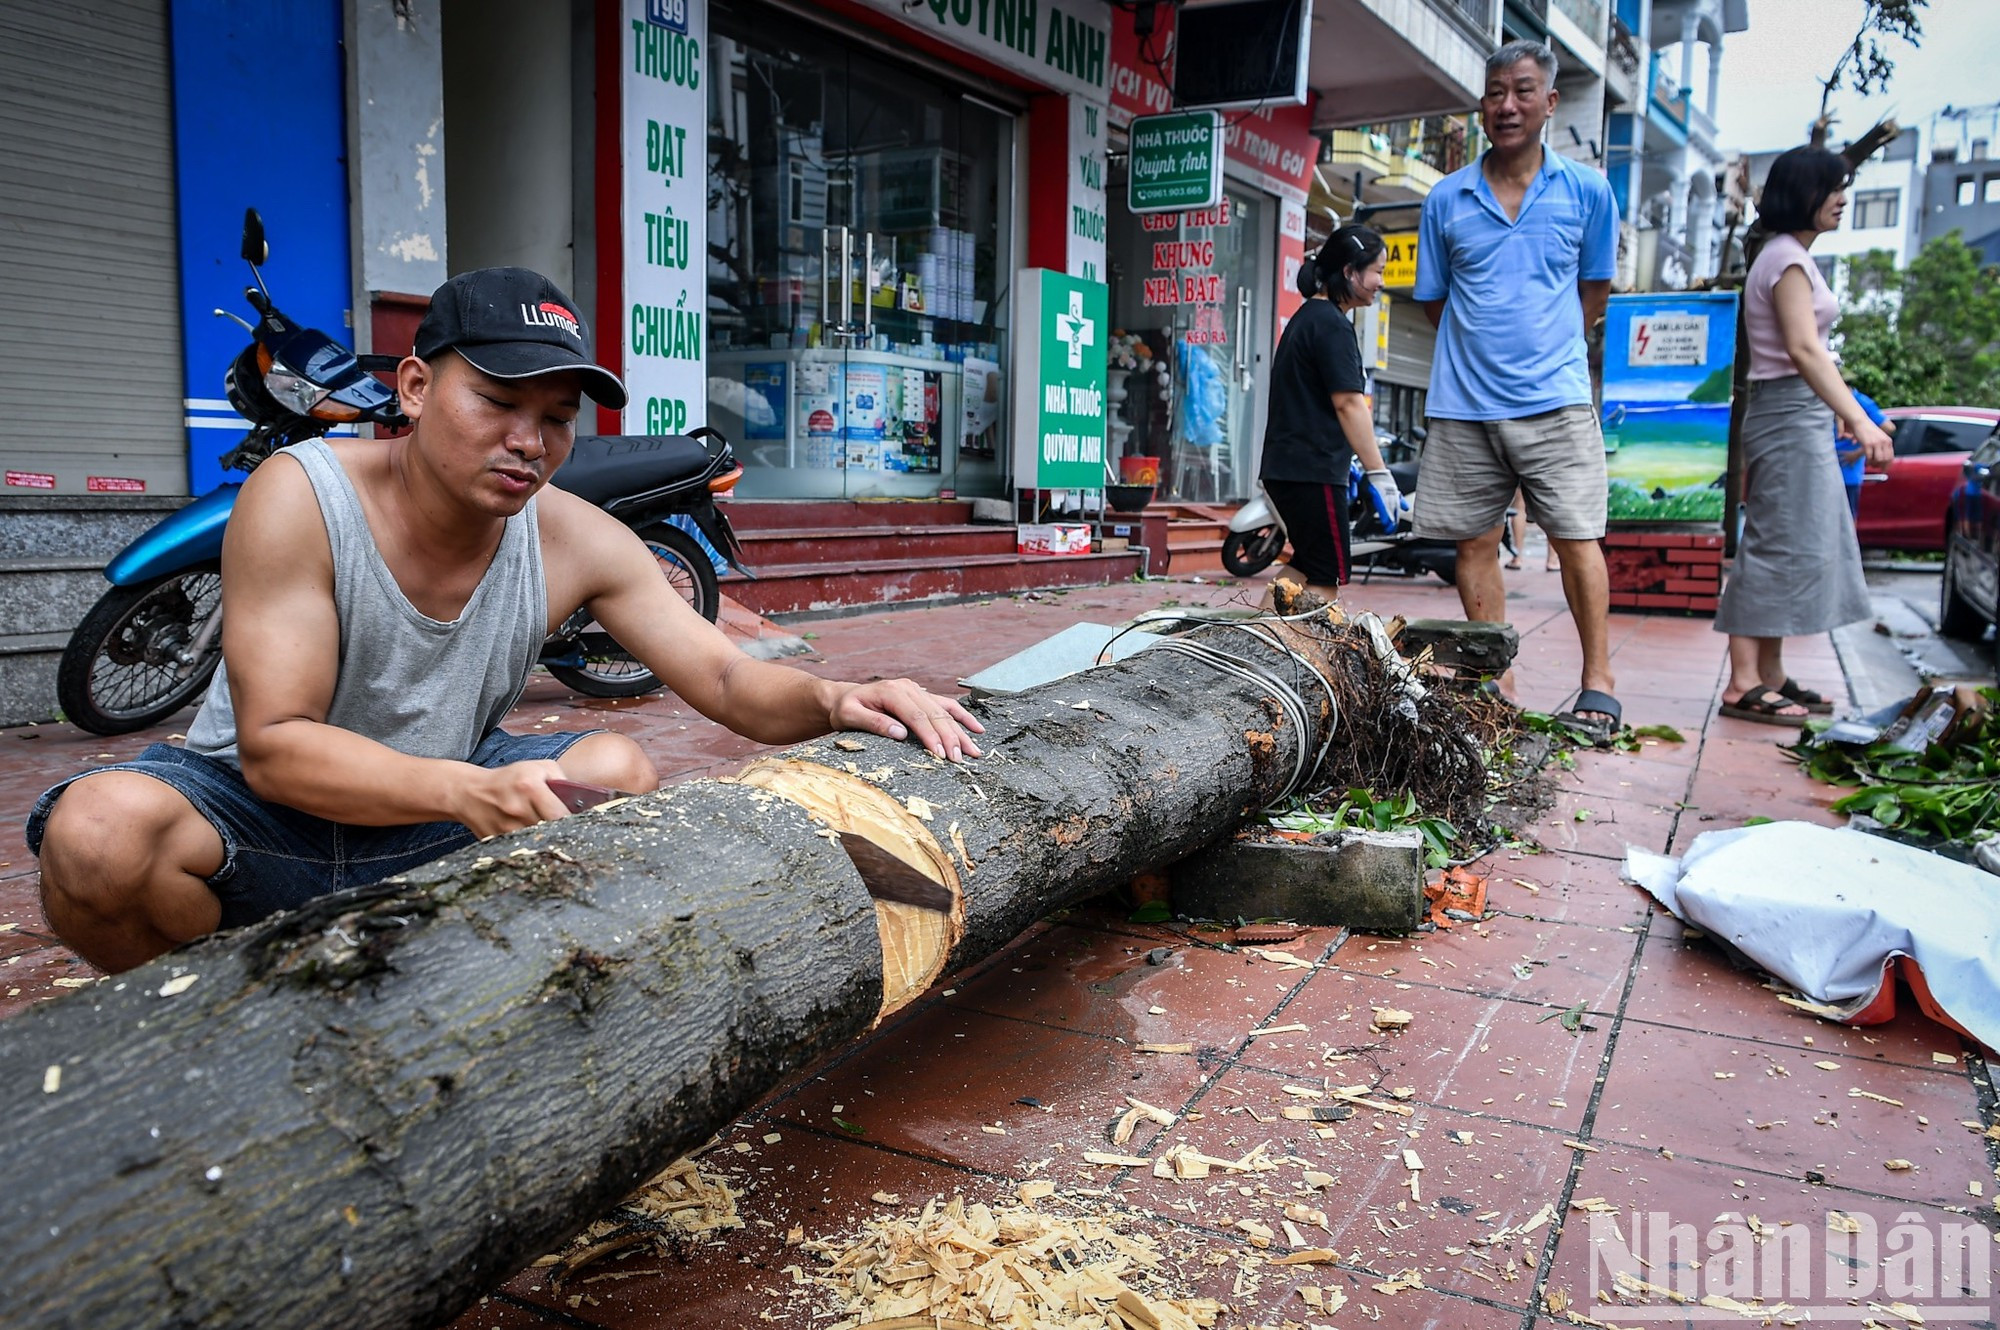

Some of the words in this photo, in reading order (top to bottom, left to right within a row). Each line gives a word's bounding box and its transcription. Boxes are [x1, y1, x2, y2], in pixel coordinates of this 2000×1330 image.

[1045, 7, 1105, 87] ANH
[646, 119, 686, 187] ĐẠT
[1136, 128, 1162, 148] NHÀ
[1165, 124, 1209, 145] THUỐC
[1180, 151, 1208, 174] Anh
[1073, 204, 1105, 244] THUỐC
[1143, 212, 1176, 231] CHO
[1186, 197, 1230, 227] THUÊ
[644, 206, 688, 270] TIÊU
[1153, 241, 1213, 270] KHUNG
[1184, 276, 1219, 310] BẠT
[631, 289, 700, 361] CHUẨN
[646, 397, 686, 436] GPP
[1045, 380, 1067, 414] NHÀ
[1069, 380, 1102, 418] THUỐC
[1043, 428, 1079, 465] QUỲNH
[1079, 436, 1101, 463] ANH
